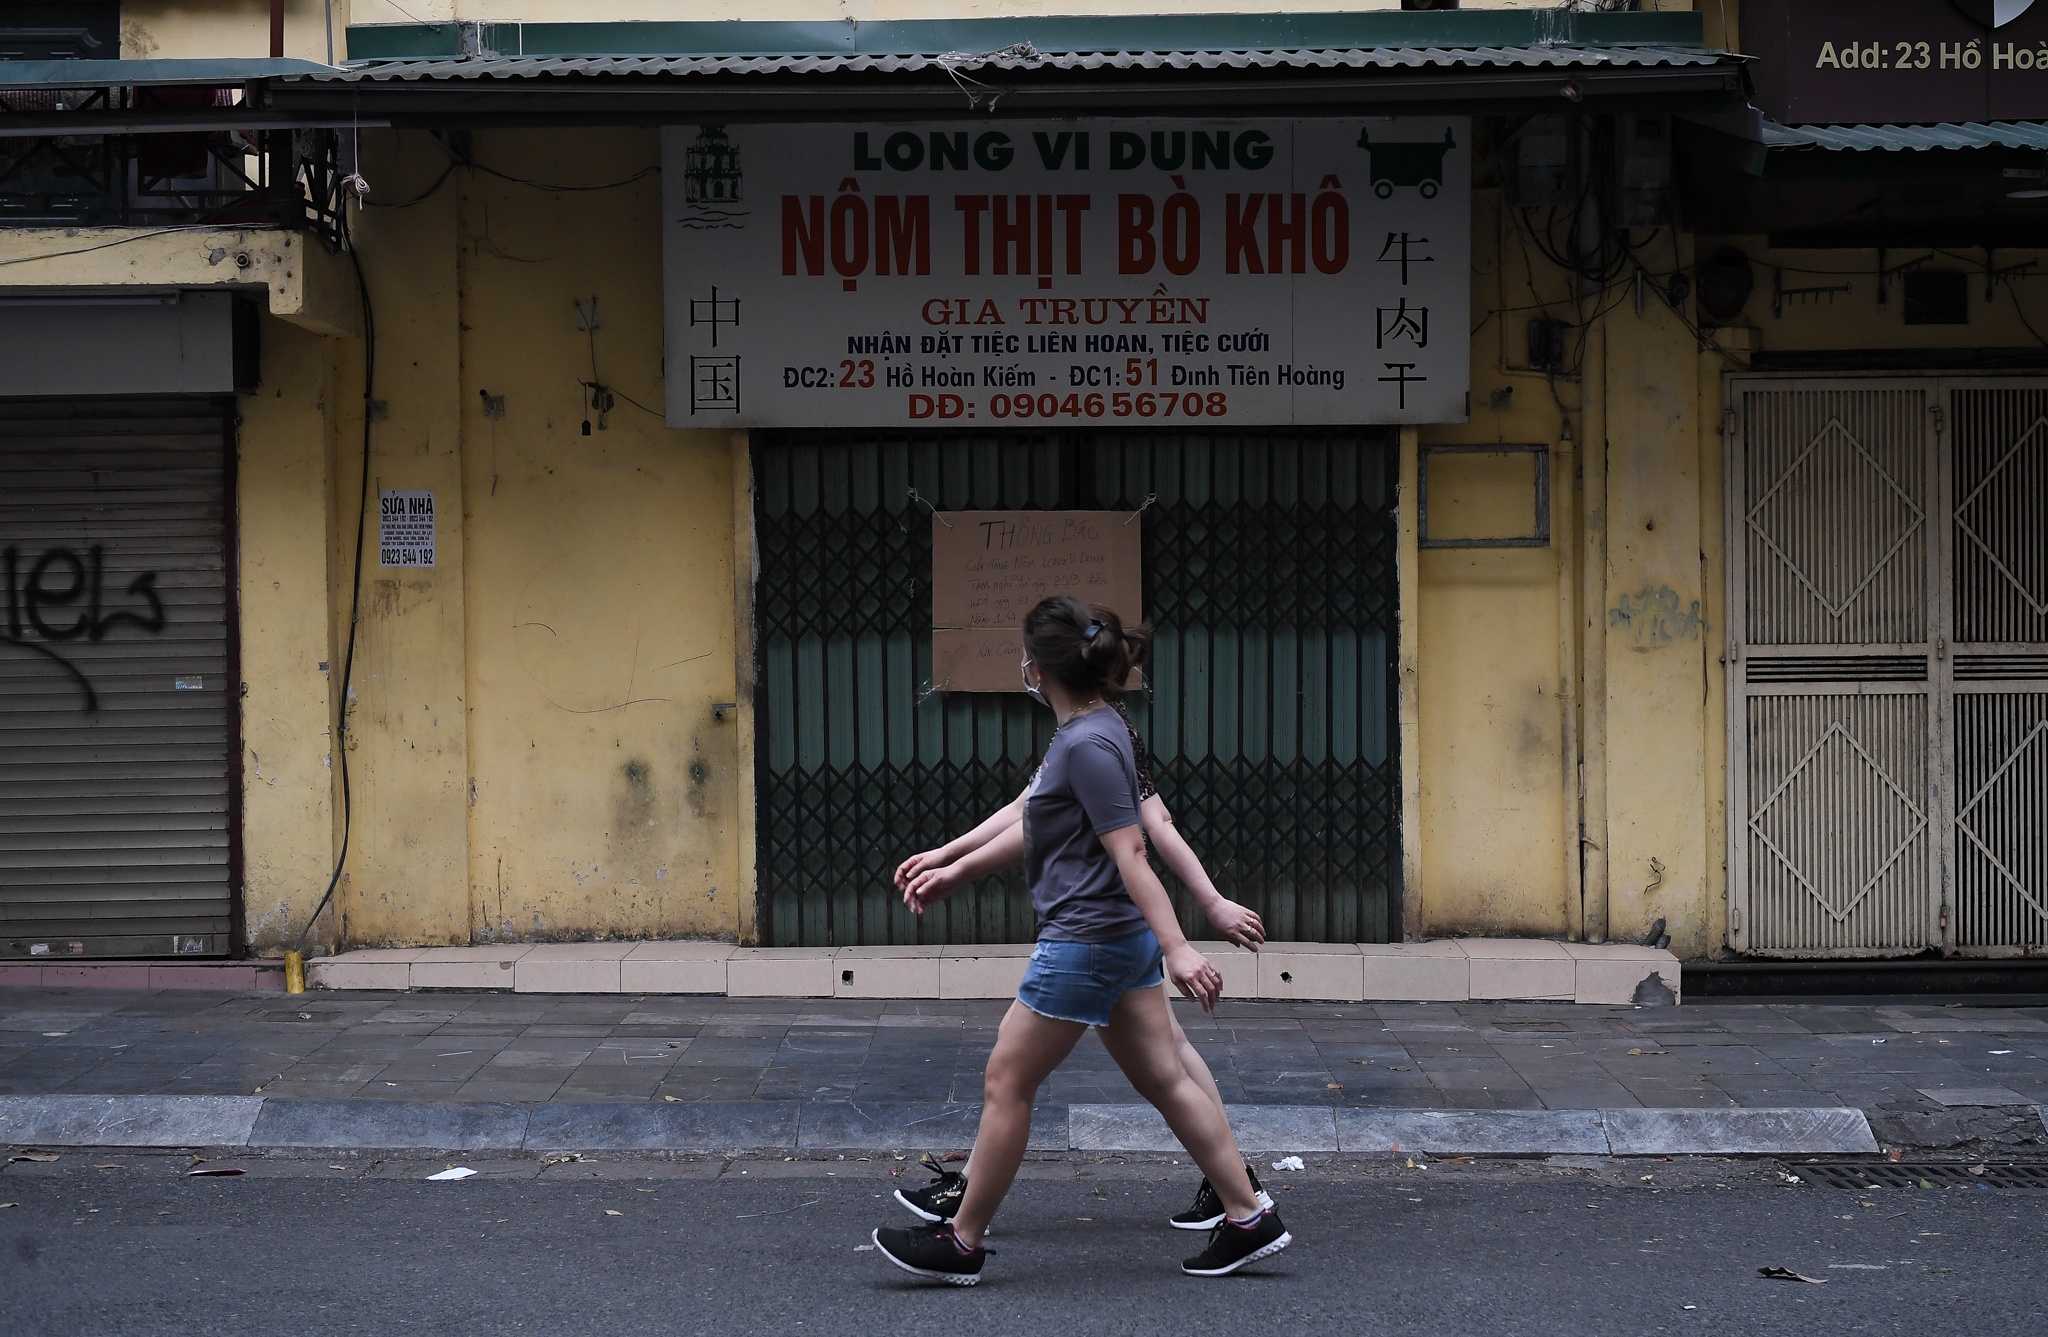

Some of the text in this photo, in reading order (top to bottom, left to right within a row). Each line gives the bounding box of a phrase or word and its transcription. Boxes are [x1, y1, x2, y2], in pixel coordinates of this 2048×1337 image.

[1816, 42, 1887, 69] Add:
[1895, 42, 1931, 69] 23
[1940, 39, 1981, 70] Hồ
[854, 130, 1273, 171] LONG VI DUNG
[782, 174, 1349, 291] NỘM THỊT BÒ KHÔ
[922, 283, 1211, 326] GIA TRUYỀN
[1376, 232, 1435, 409] 牛肉干
[690, 285, 741, 416] 中国
[848, 328, 1270, 360] NHẬN ĐẶT TIỆC LIÊN HOAN, TIỆC CƯỚI
[886, 363, 914, 388] Hồ
[922, 366, 975, 388] Hoàn
[984, 364, 1036, 387] Kiếm
[1227, 365, 1270, 386] Tiên
[1278, 365, 1345, 390] Hoàng
[909, 394, 976, 419] DĐ:
[382, 491, 433, 514] SỬA NHÀ
[979, 515, 1098, 550] THÔNG BÁO
[382, 549, 433, 564] 0923 544 192
